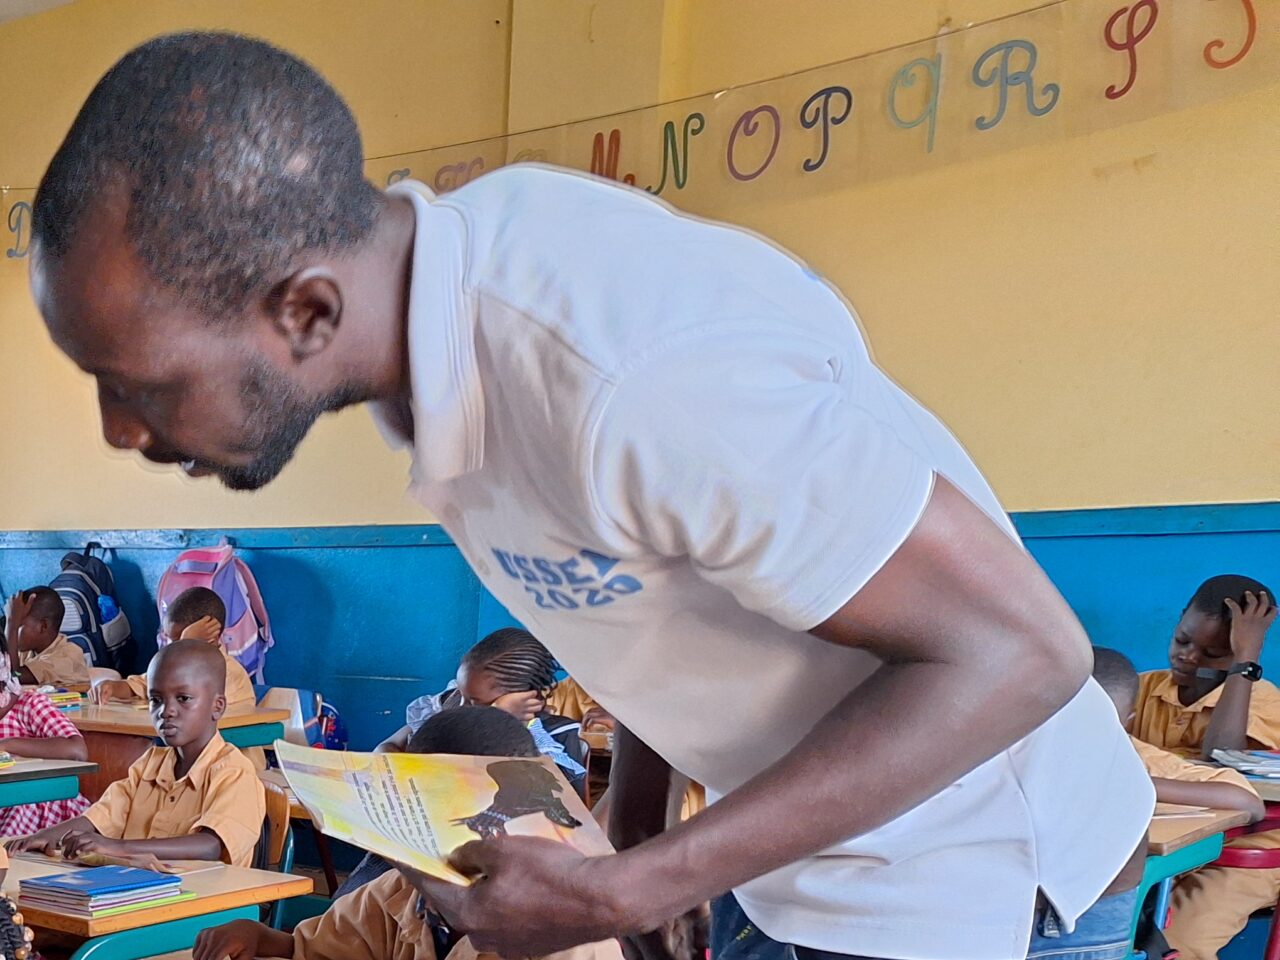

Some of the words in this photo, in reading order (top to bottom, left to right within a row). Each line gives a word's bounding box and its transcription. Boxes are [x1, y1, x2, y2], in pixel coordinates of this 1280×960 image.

[644, 113, 706, 196] N
[726, 104, 781, 182] O
[799, 85, 853, 173] P
[971, 39, 1060, 131] R
